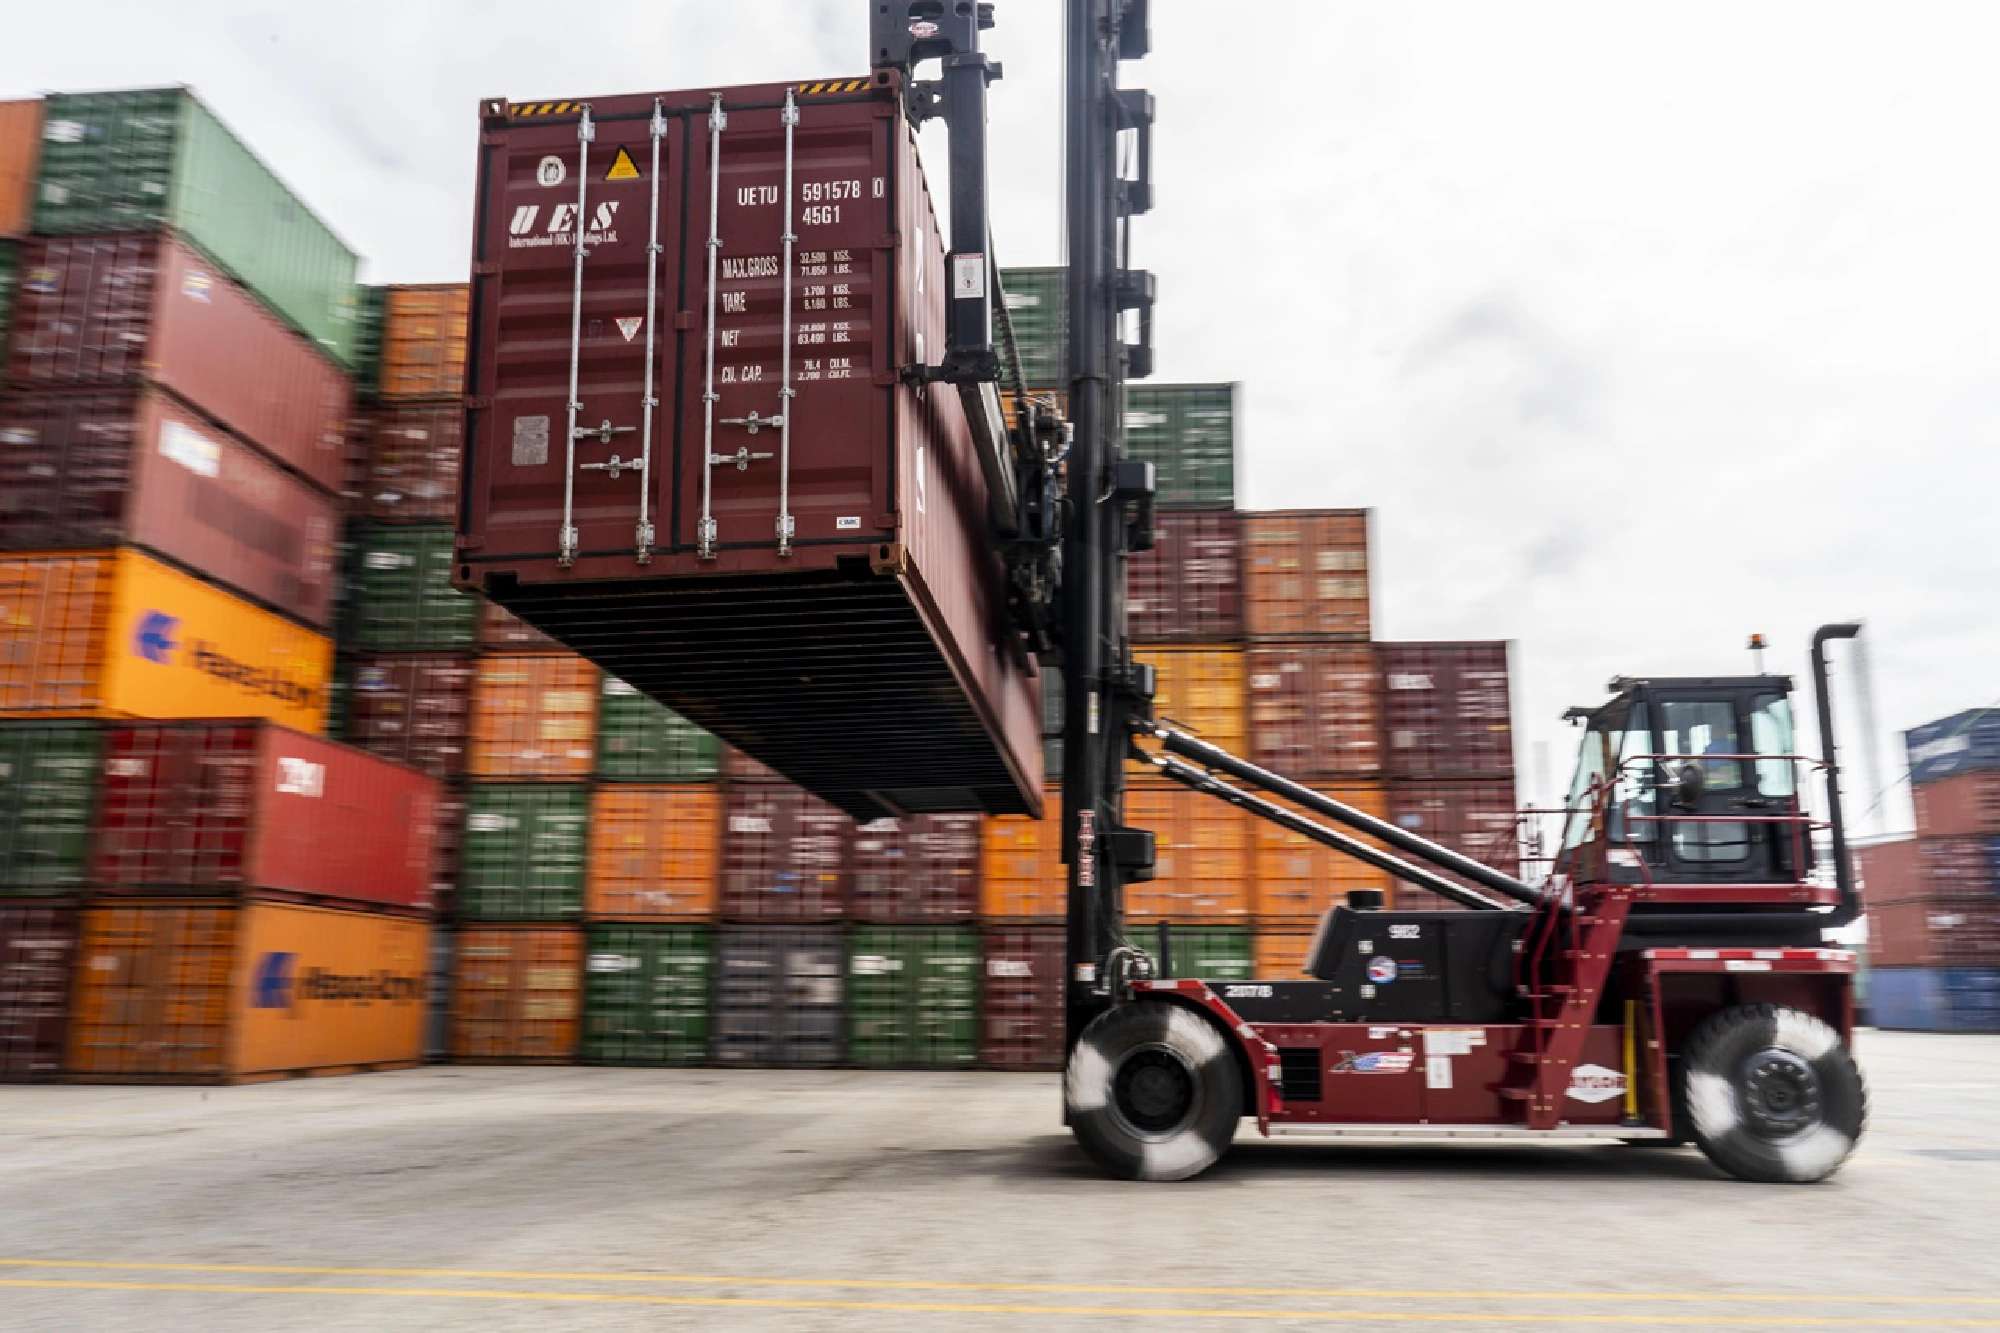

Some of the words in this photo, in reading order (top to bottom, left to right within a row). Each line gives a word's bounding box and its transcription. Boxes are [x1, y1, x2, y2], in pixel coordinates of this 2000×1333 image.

[738, 186, 778, 206] UETU
[803, 180, 861, 202] 591578
[510, 202, 619, 234] UES
[803, 205, 840, 225] 45G1
[722, 292, 746, 313] TARE
[721, 330, 741, 347] NET
